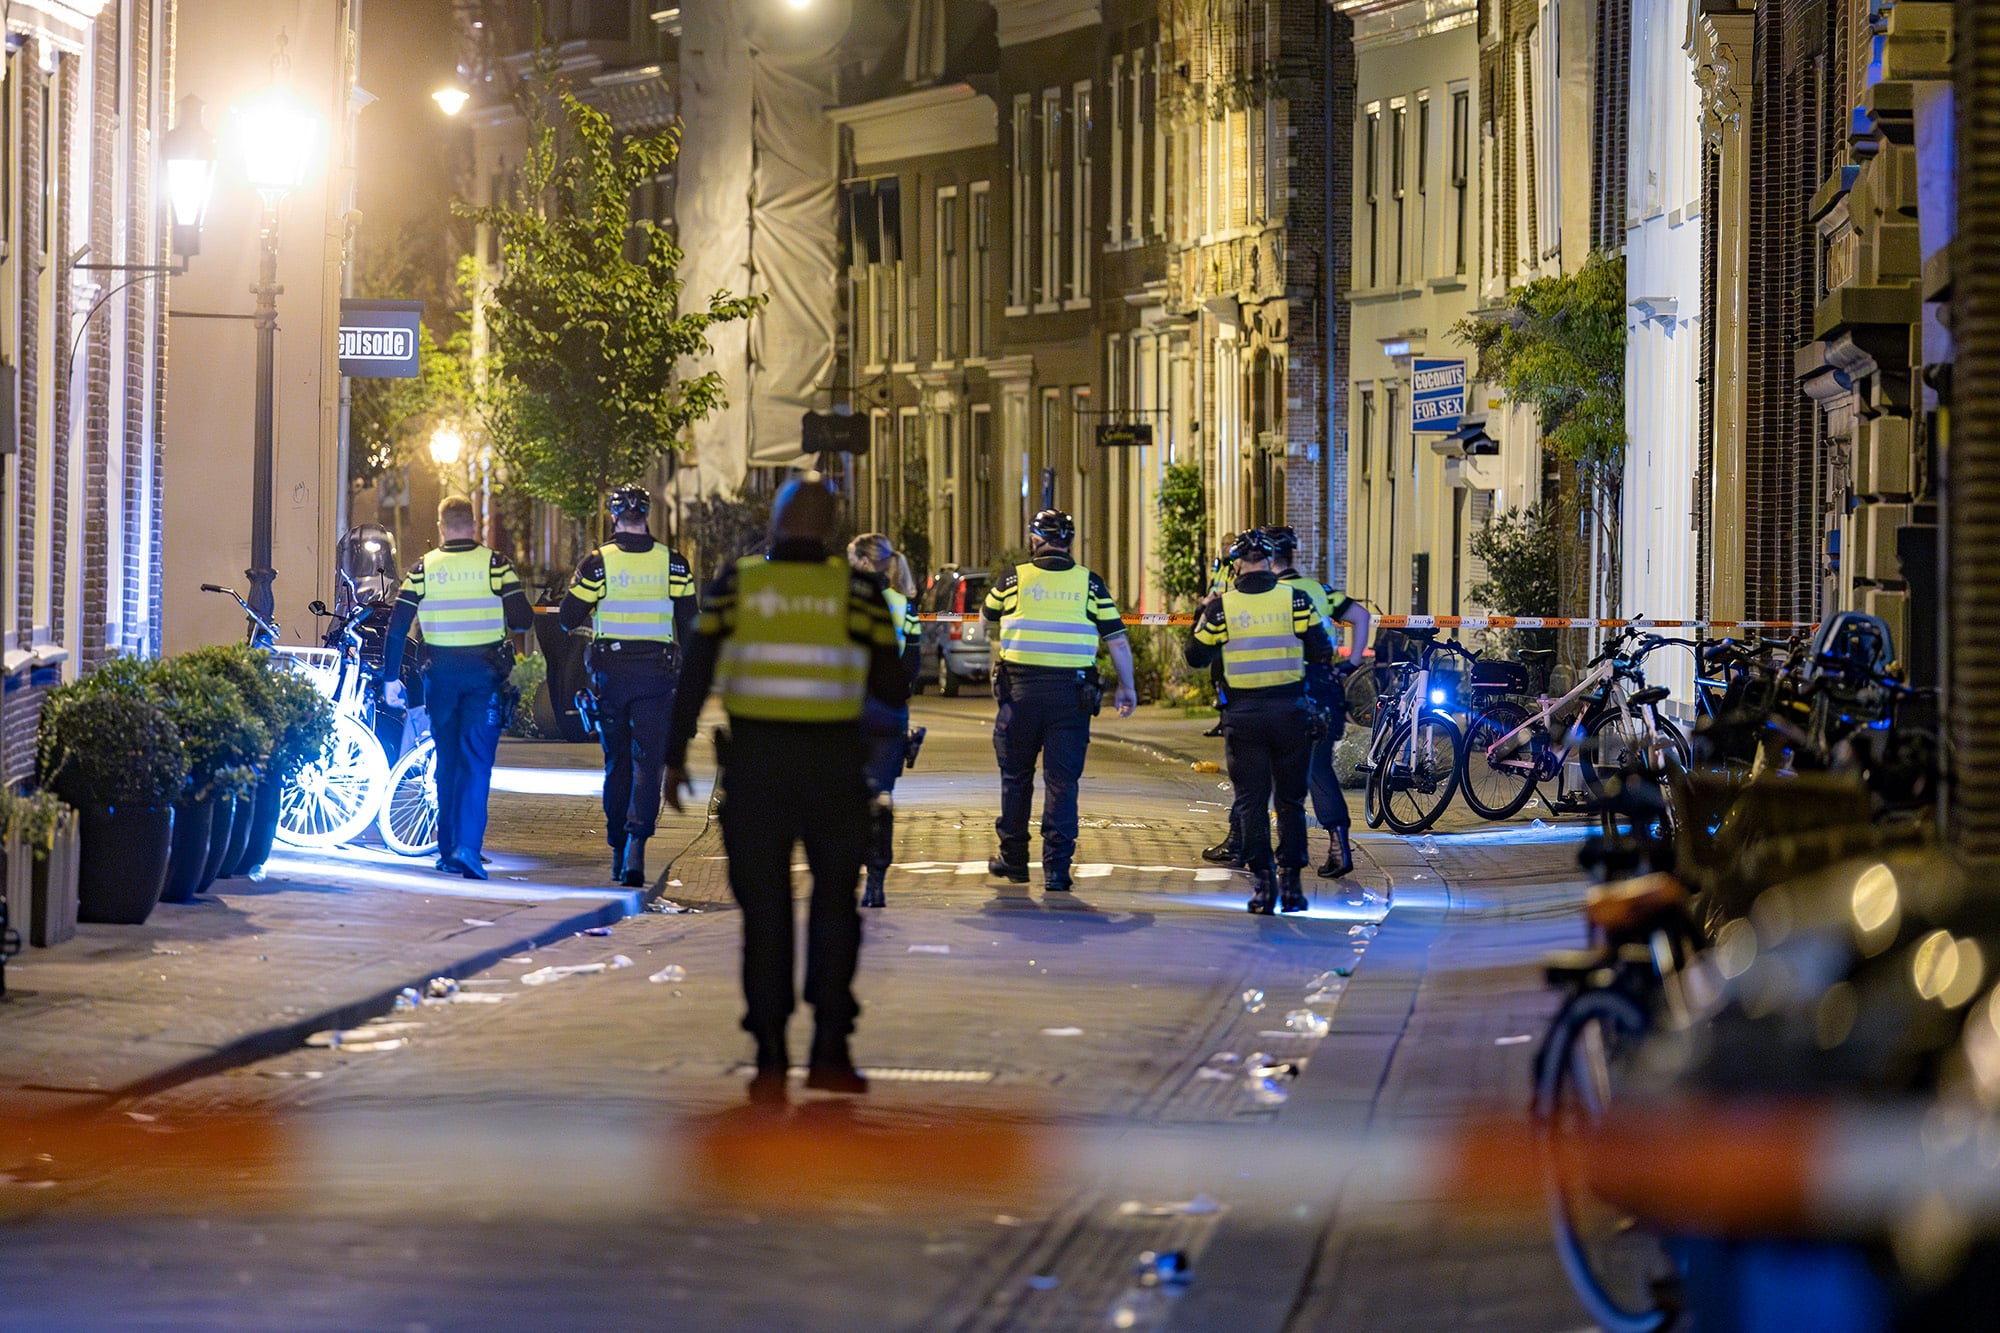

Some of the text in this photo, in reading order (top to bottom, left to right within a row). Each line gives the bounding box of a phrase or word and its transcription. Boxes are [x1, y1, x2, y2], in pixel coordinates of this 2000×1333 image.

[339, 329, 404, 357] episode
[1415, 369, 1463, 389] COCONUTS
[1415, 398, 1461, 419] FOR SEX
